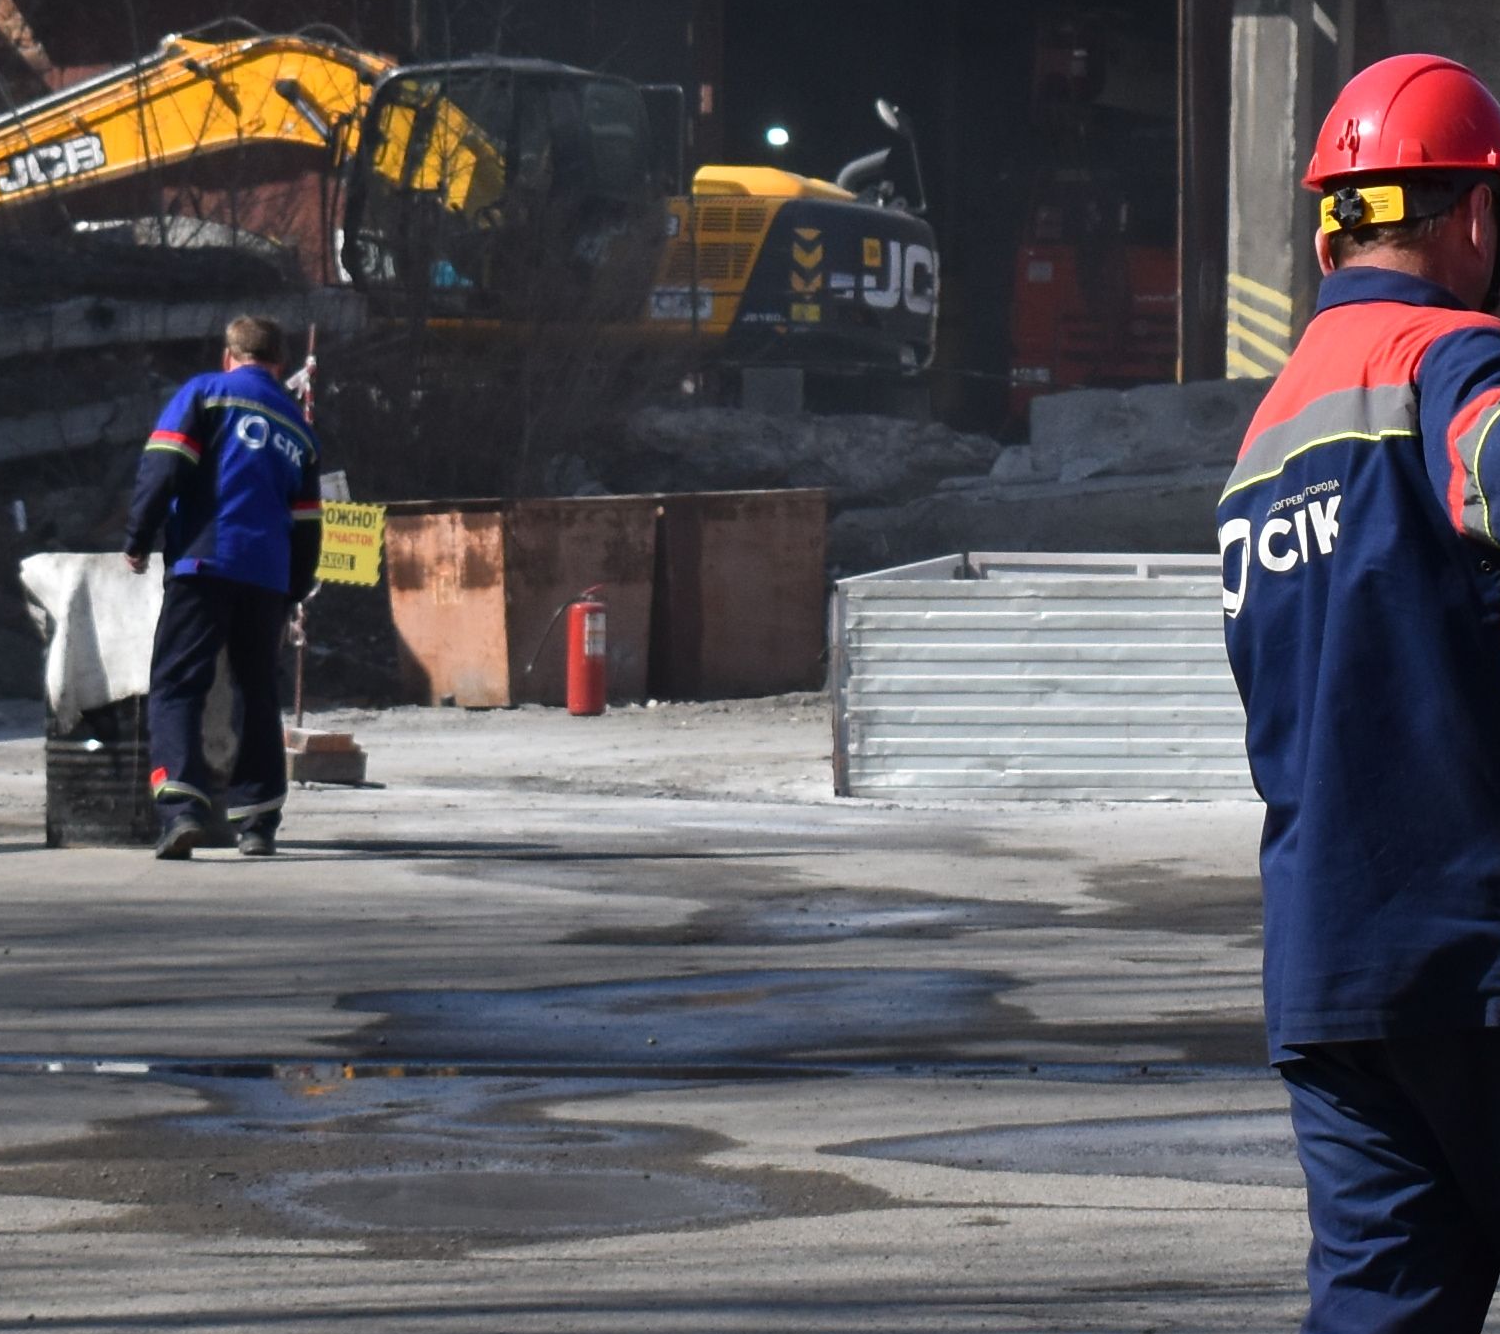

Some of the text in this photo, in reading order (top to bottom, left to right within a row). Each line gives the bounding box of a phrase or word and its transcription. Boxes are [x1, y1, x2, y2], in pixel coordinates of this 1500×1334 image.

[863, 241, 938, 315] JC
[273, 432, 304, 468] СГК
[1305, 478, 1341, 497] ГОРОДА
[325, 508, 377, 529] ОЖНО!
